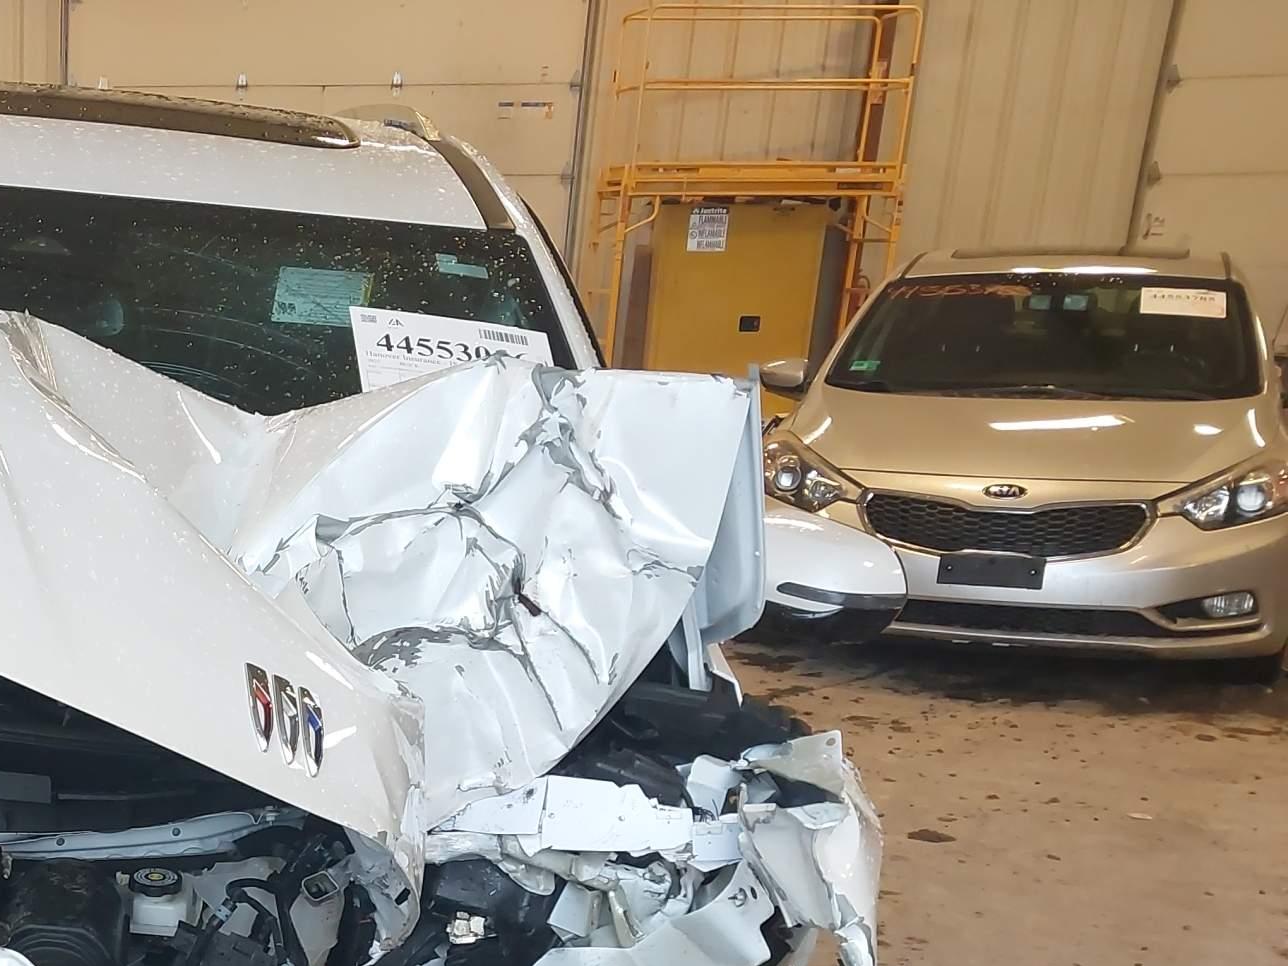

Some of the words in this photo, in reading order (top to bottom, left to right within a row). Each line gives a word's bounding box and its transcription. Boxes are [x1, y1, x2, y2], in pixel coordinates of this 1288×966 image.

[698, 215, 727, 225] FLAMMABLE
[376, 334, 528, 361] 445530
[366, 349, 400, 360] Hanover
[402, 354, 441, 365] Insurance
